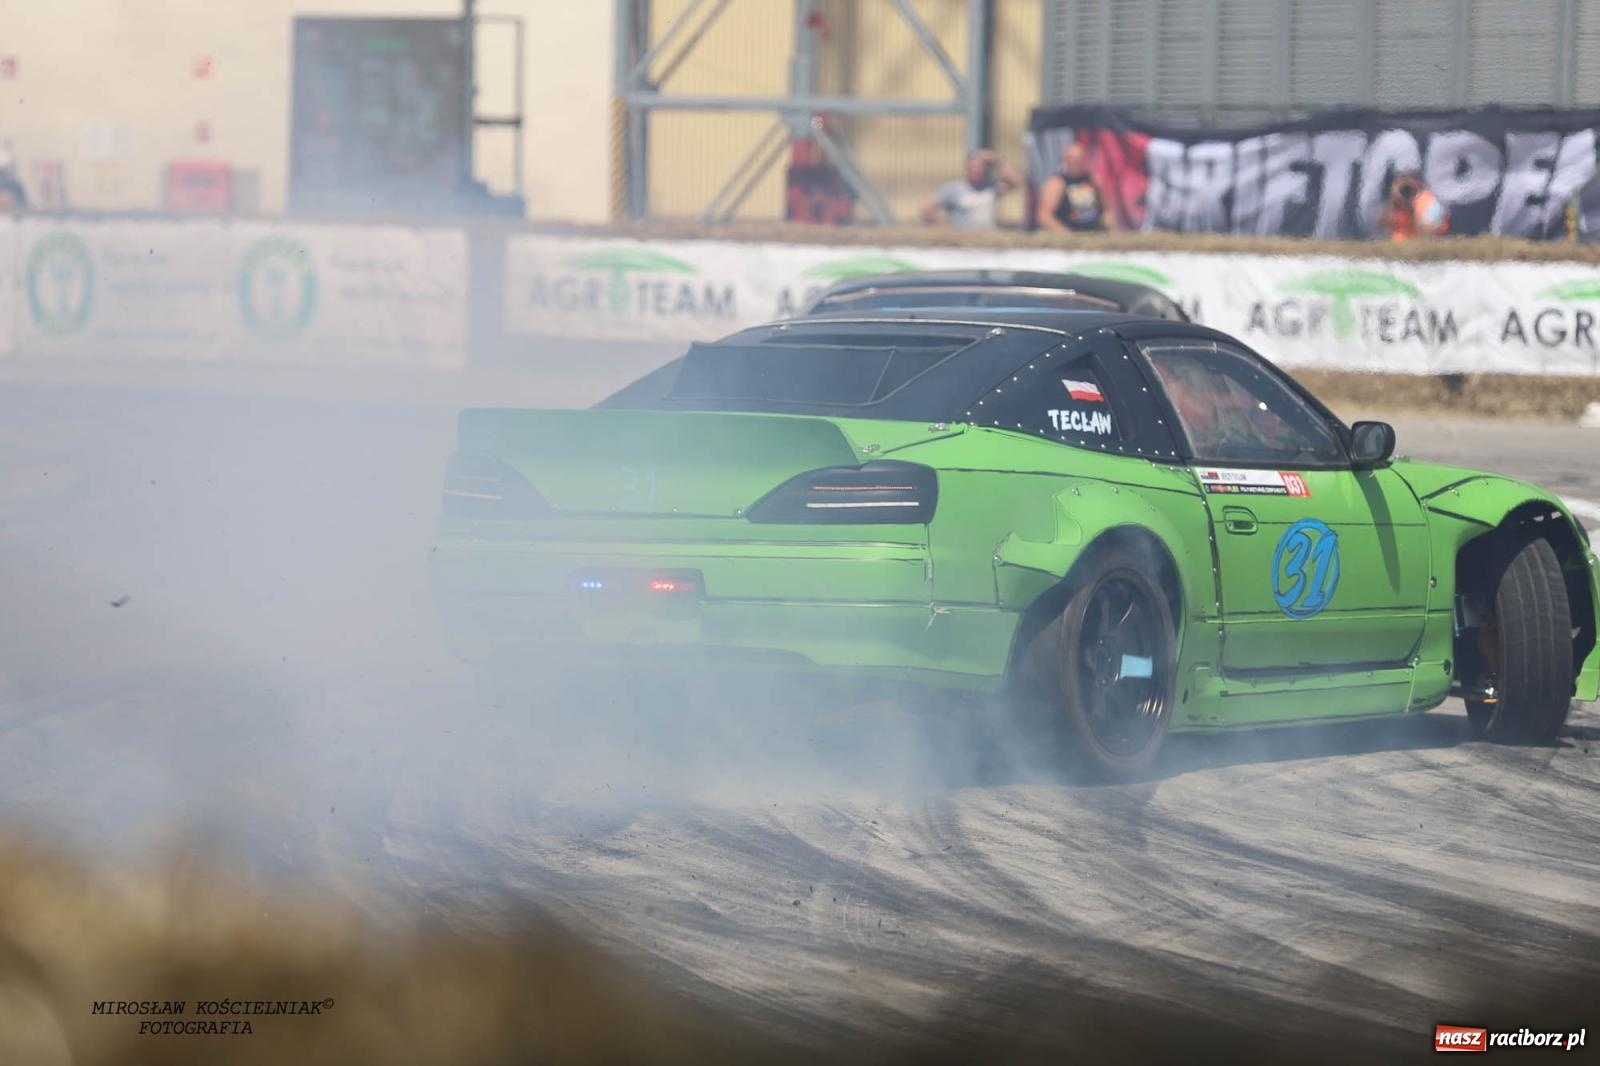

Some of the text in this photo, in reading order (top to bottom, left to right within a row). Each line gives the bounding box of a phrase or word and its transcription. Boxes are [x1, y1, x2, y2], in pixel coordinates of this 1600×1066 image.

[1047, 409, 1112, 435] TECŁAW
[1283, 474, 1307, 497] 031
[1273, 530, 1339, 608] 31
